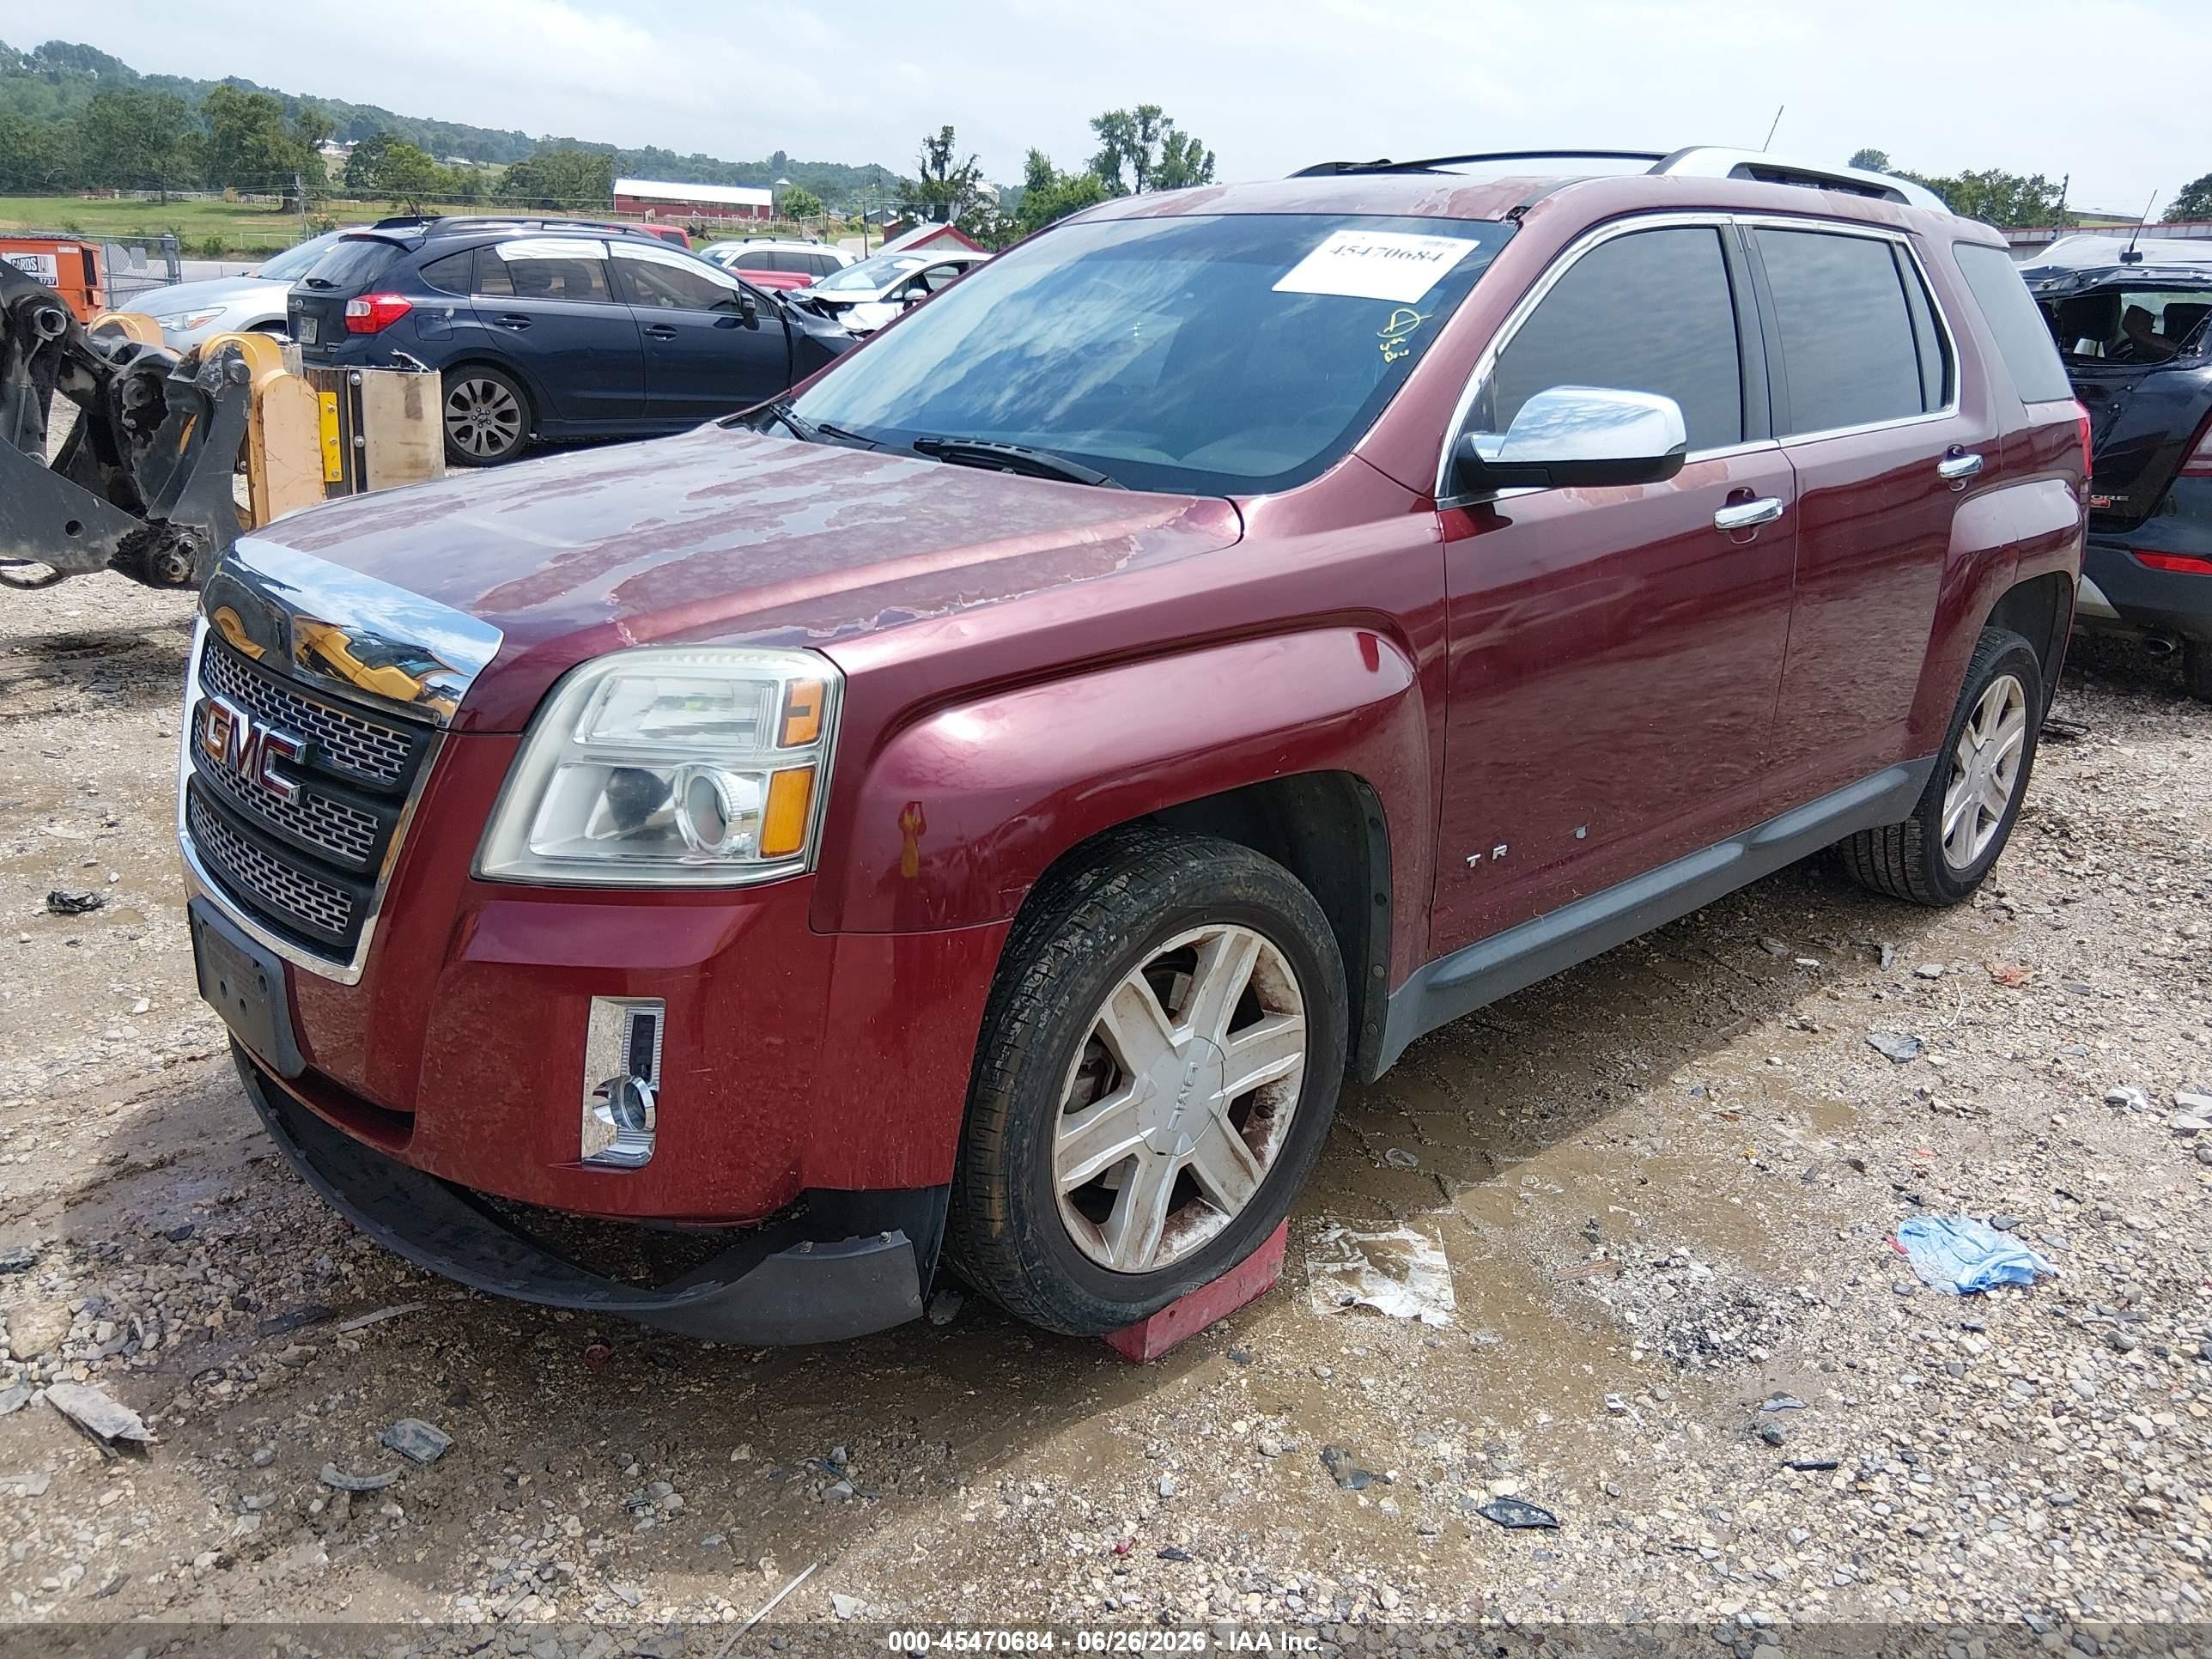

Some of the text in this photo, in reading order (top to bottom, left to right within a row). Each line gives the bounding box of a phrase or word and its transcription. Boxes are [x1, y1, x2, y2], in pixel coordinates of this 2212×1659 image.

[11, 257, 38, 272] CARDS
[1328, 244, 1445, 263] 45470684
[204, 696, 307, 806] GMC
[1167, 1061, 1200, 1132] GMC
